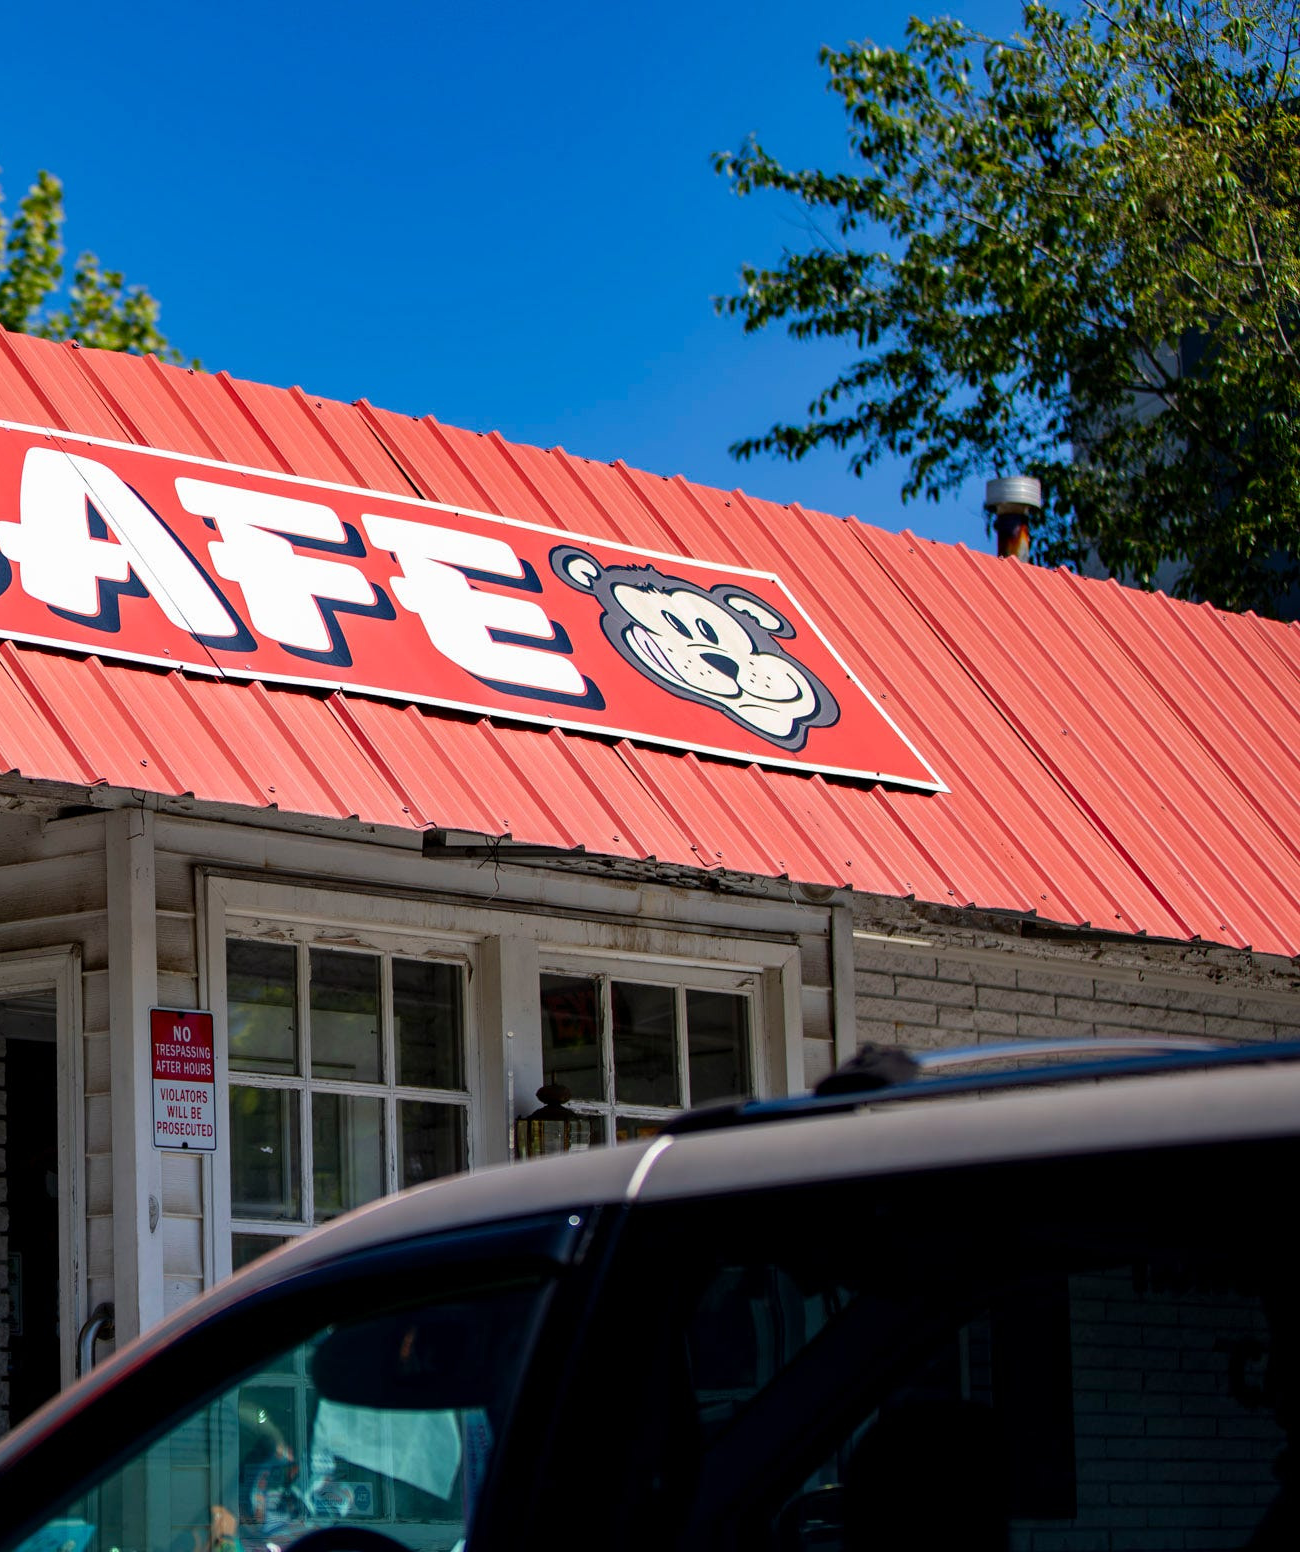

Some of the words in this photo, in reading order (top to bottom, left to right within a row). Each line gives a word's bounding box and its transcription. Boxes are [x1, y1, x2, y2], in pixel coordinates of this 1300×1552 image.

[173, 1026, 191, 1042] NO
[155, 1043, 211, 1059] TRESPASSING
[156, 1060, 181, 1073] AFTER
[184, 1062, 212, 1076] HOURS
[160, 1088, 208, 1103] VIOLATORS
[167, 1105, 188, 1119] WILL
[191, 1107, 202, 1119] BE
[156, 1121, 213, 1137] PROSECUTED
